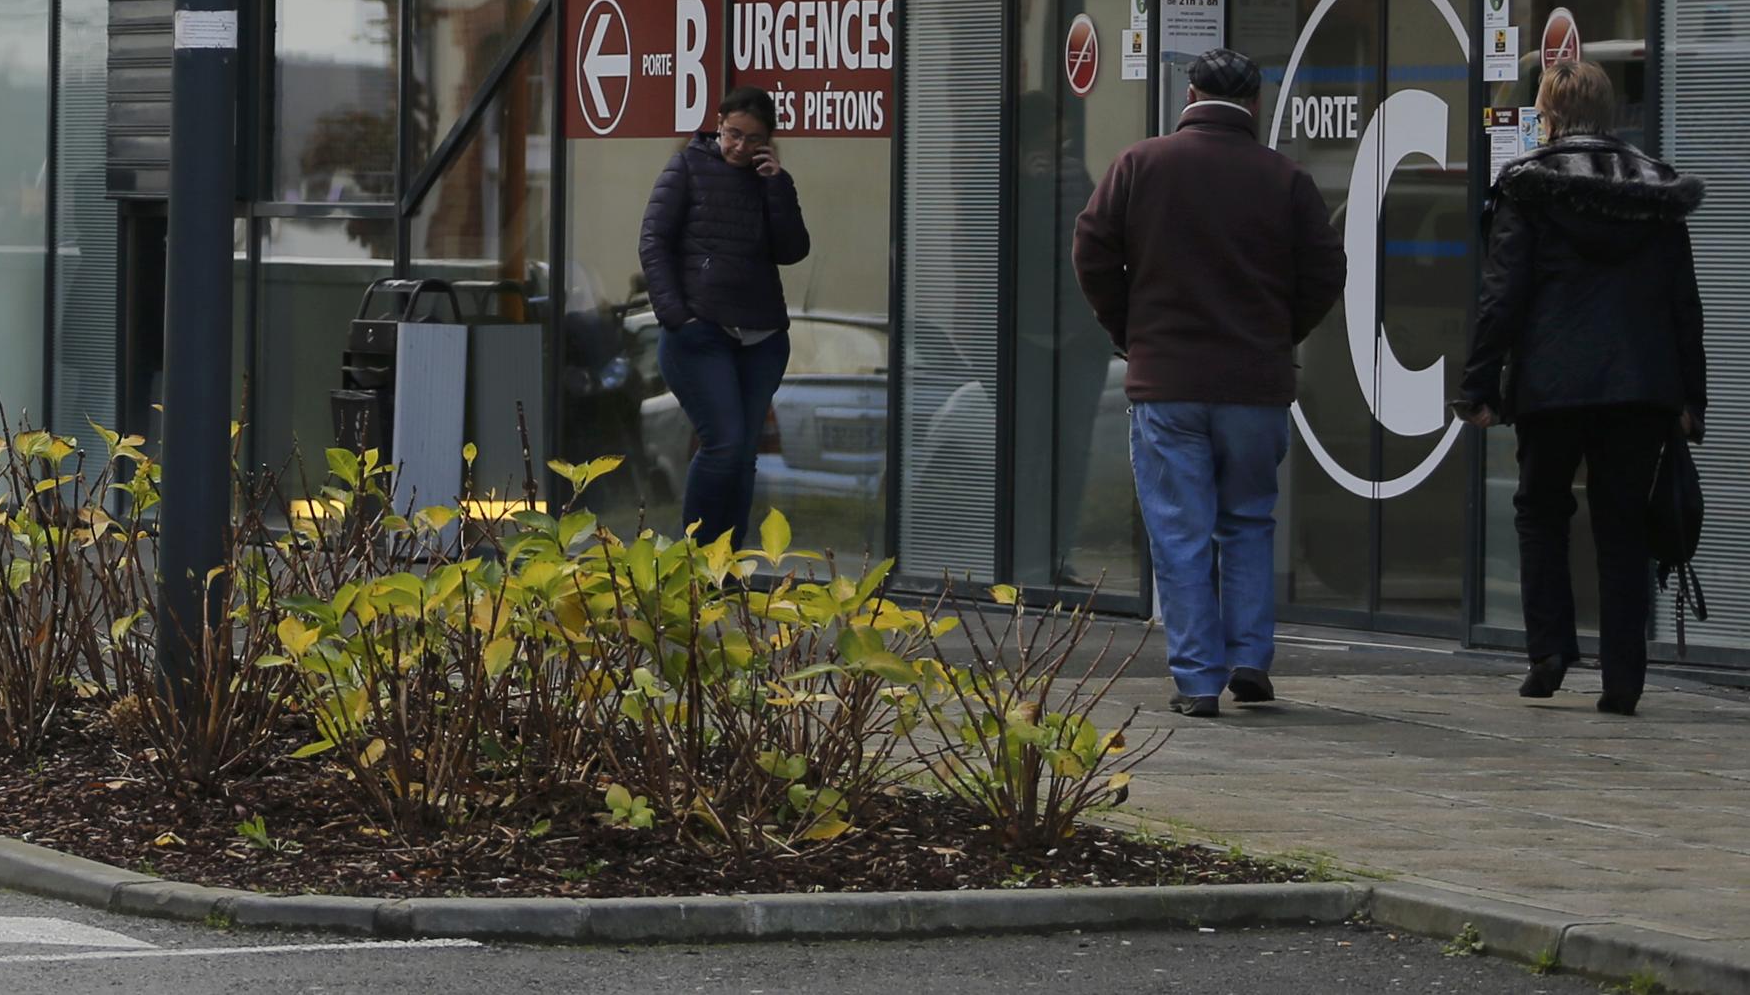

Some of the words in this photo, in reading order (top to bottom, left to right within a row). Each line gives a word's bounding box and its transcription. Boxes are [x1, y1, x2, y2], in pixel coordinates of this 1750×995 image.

[642, 53, 672, 77] PORTE
[767, 81, 796, 131] ÈS
[803, 81, 884, 131] PIÉTONS
[1291, 95, 1359, 140] PORTE
[1343, 88, 1449, 437] C
